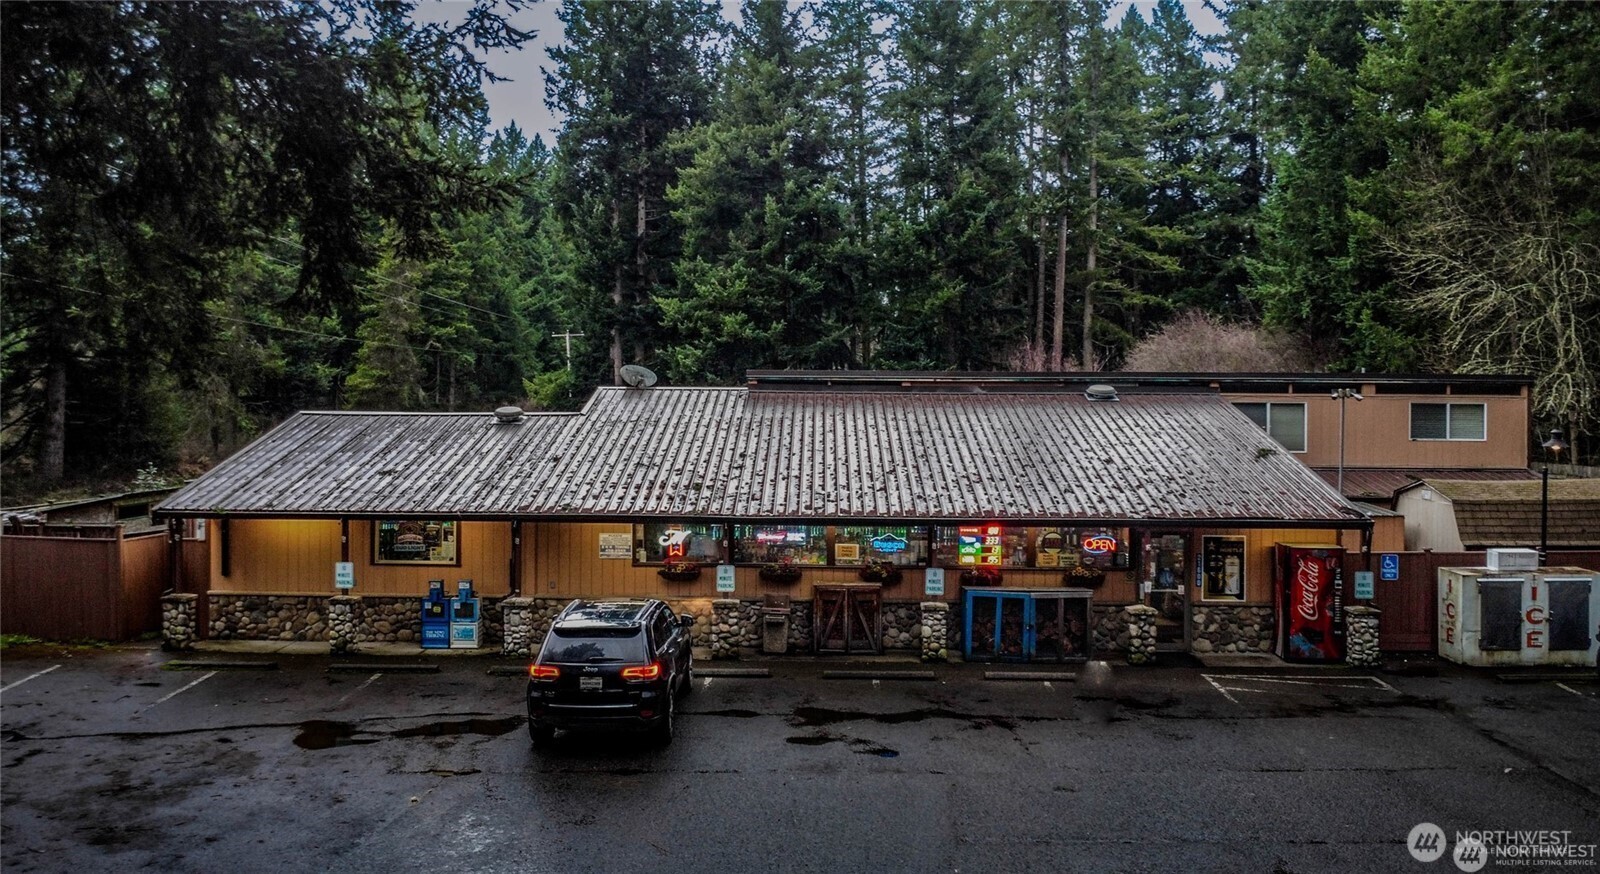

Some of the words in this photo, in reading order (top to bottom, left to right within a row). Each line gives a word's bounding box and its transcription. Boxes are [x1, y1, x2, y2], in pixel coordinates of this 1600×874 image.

[873, 541, 906, 549] BUSCH
[1084, 539, 1115, 551] OPEN
[1297, 558, 1319, 621] Coca-Cola
[1445, 579, 1456, 645] ICE
[1525, 586, 1545, 648] ICE
